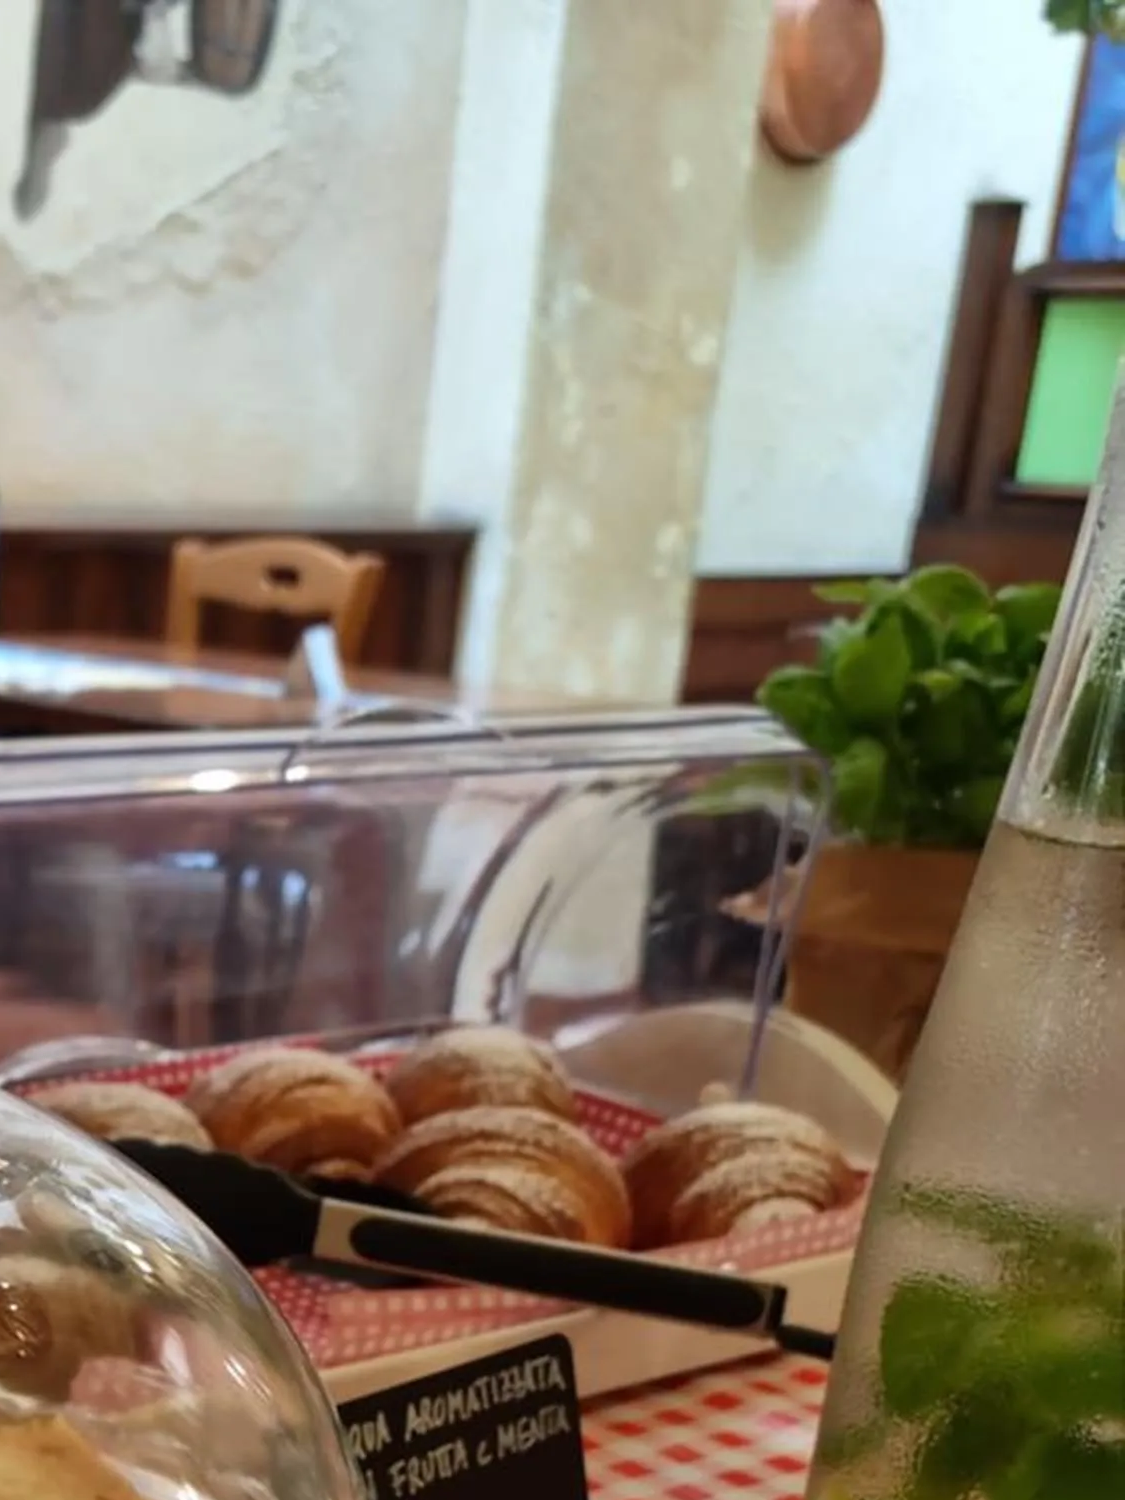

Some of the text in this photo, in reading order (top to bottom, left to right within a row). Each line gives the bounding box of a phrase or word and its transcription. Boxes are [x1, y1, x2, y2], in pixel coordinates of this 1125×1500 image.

[347, 1411, 392, 1460] QUA
[388, 1438, 469, 1497] FRUTTA
[497, 1405, 571, 1458] MENTA
